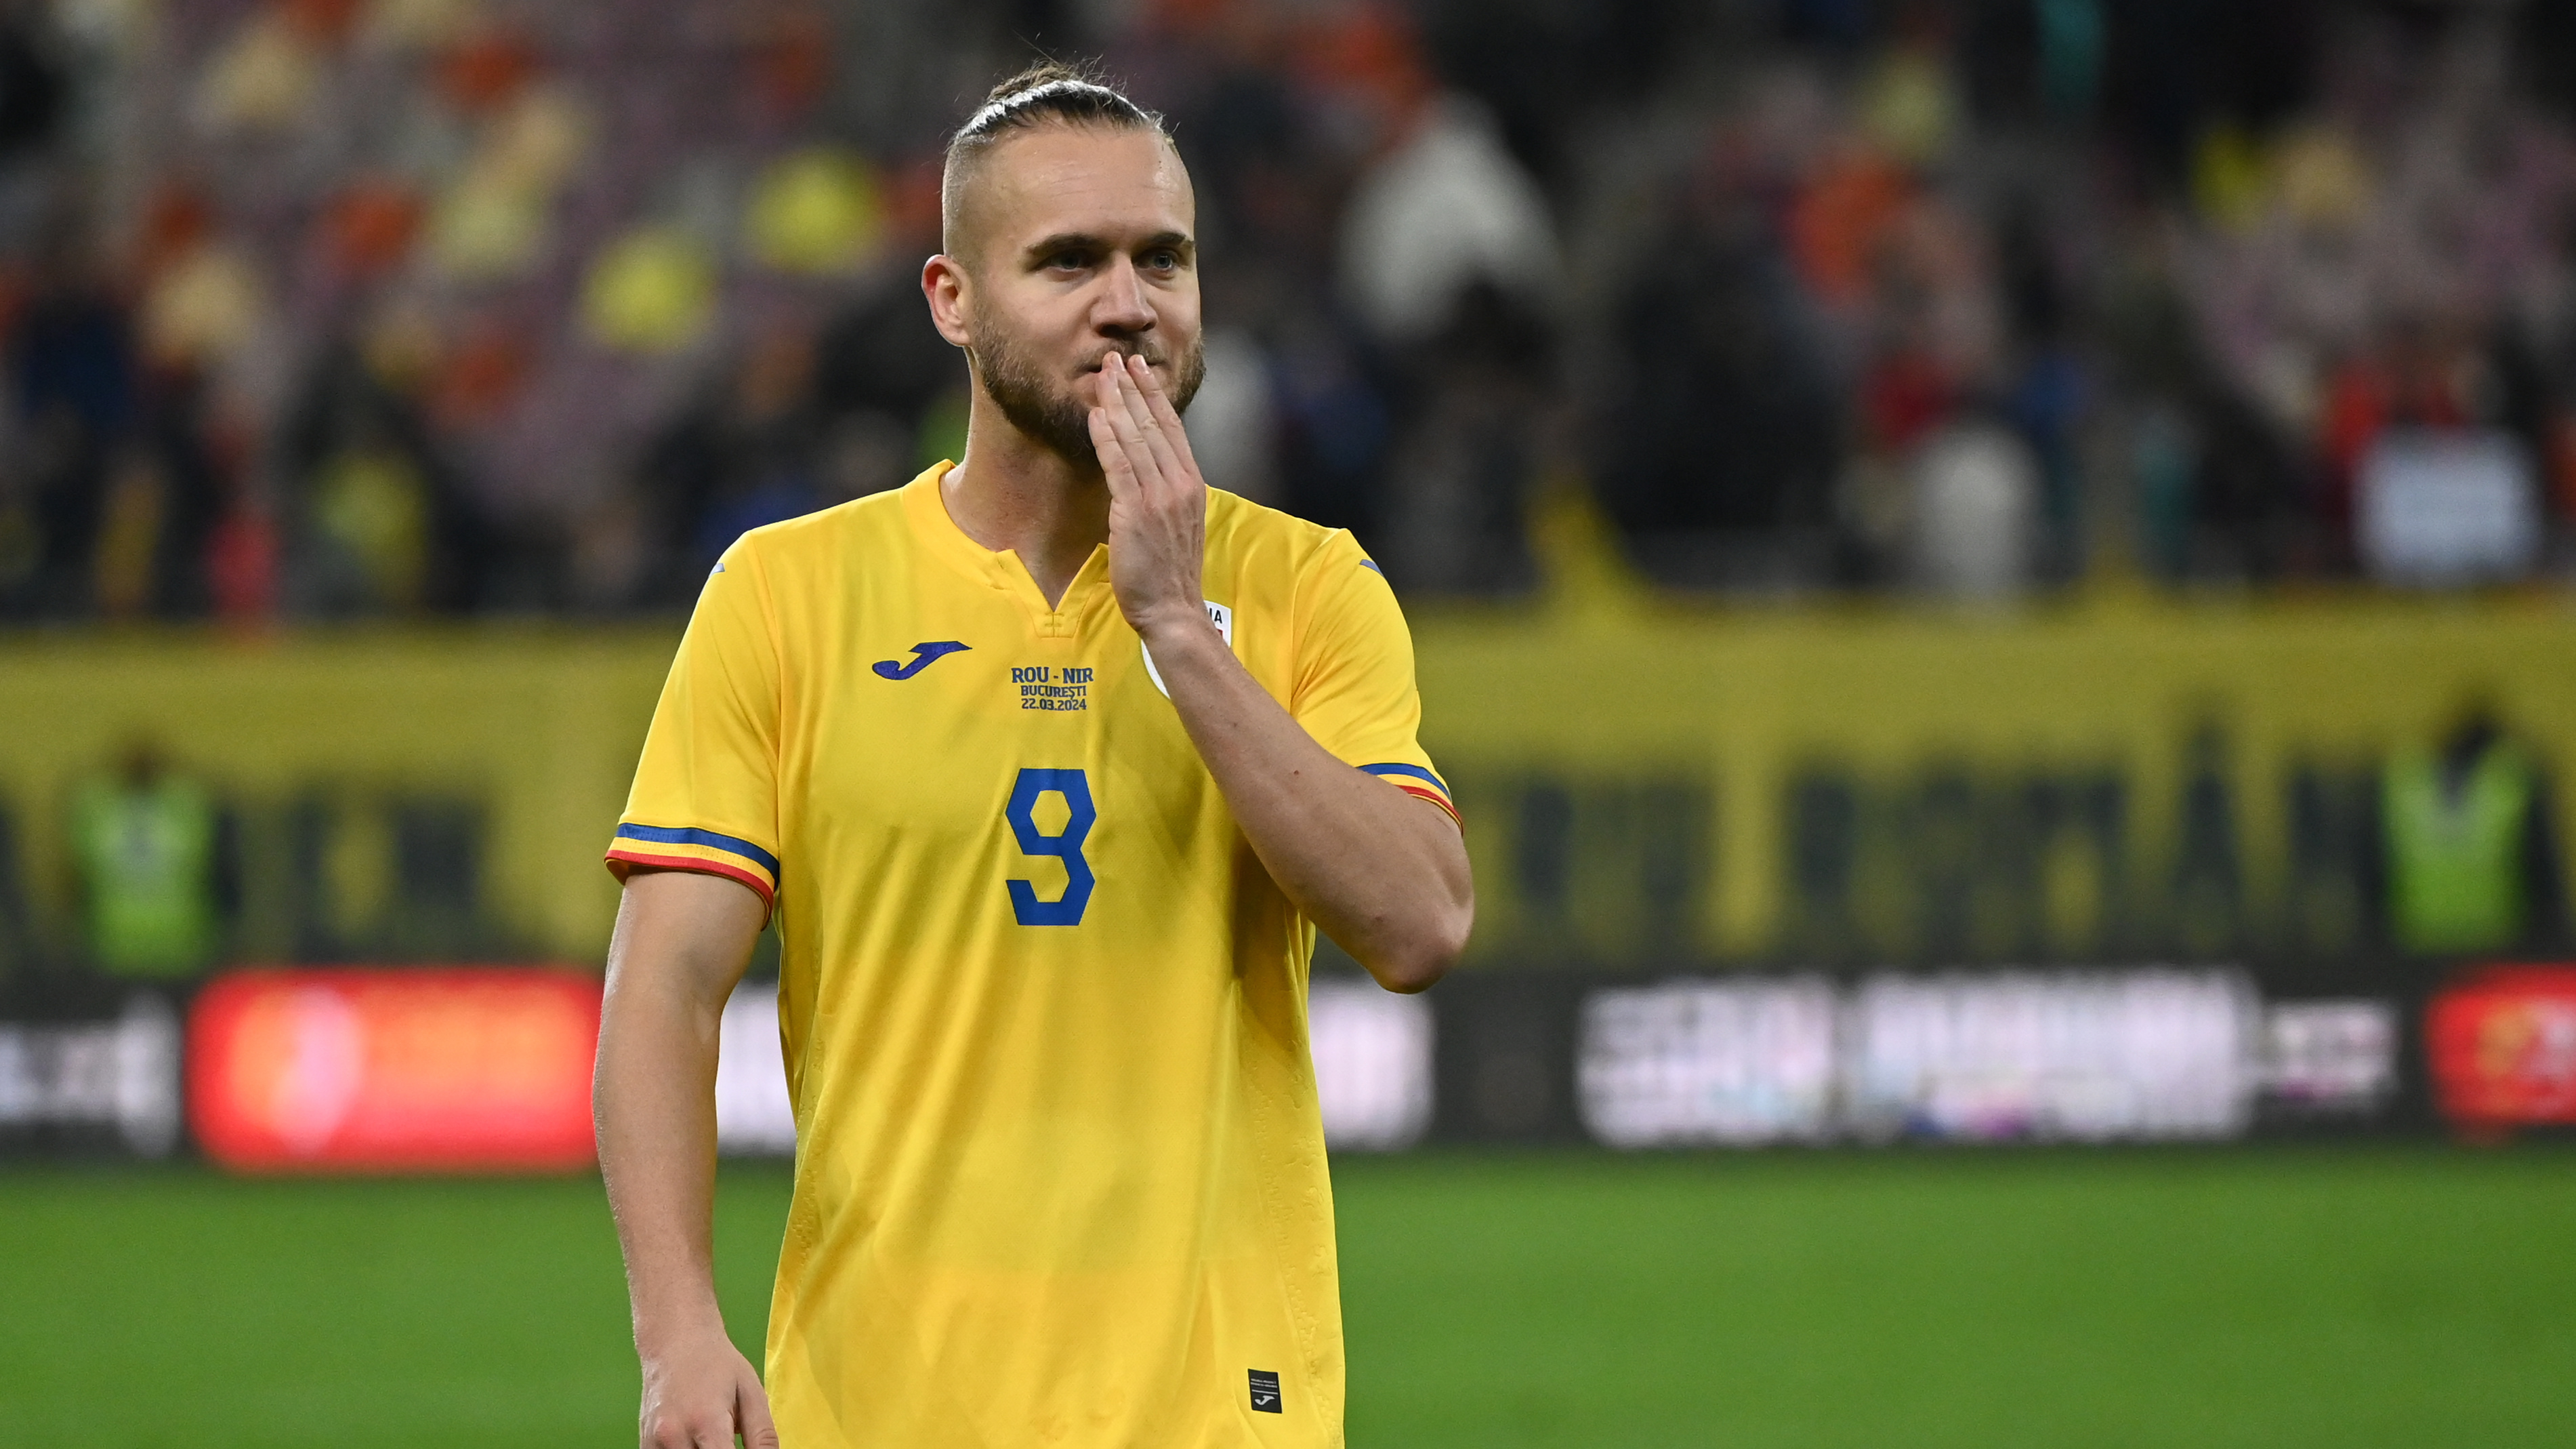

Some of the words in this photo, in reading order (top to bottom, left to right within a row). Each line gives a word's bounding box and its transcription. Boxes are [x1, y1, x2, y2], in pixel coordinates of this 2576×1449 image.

[1011, 667, 1050, 683] ROU
[1062, 668, 1094, 684] NIR
[1021, 698, 1087, 711] 22.03.2024
[1005, 768, 1096, 926] 9
